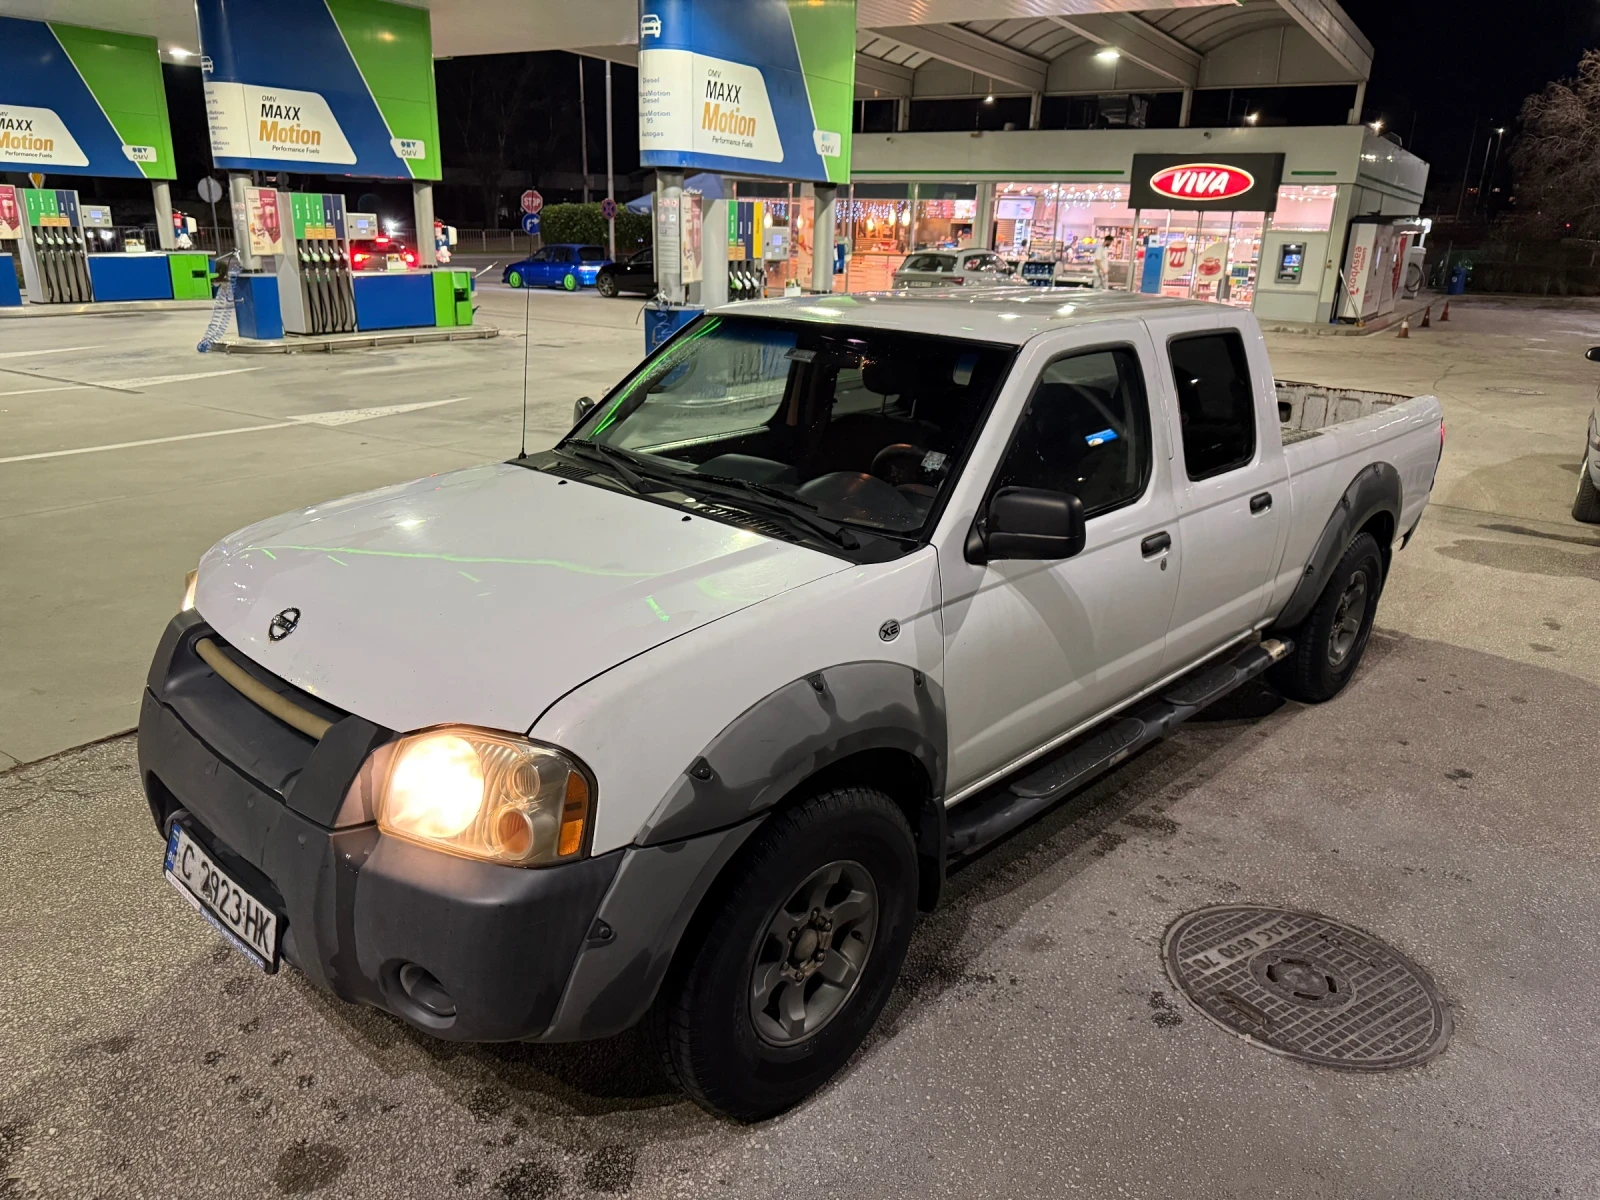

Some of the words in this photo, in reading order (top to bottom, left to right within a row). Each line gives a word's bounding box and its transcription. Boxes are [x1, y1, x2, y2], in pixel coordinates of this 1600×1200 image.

[708, 69, 722, 79] OMV
[261, 95, 277, 103] OMV
[705, 79, 742, 104] MAXX
[260, 103, 301, 121] MAXX
[701, 101, 757, 138] Motion
[0, 131, 54, 151] Motion
[259, 120, 321, 146] Motion
[711, 135, 741, 147] Performance
[741, 140, 754, 149] Fuels
[272, 145, 305, 154] Performance
[401, 149, 418, 157] OMV
[1171, 170, 1230, 194] VIVA
[523, 197, 541, 207] STOP
[1349, 246, 1363, 289] easybox
[881, 624, 899, 639] XE
[182, 844, 195, 881] C
